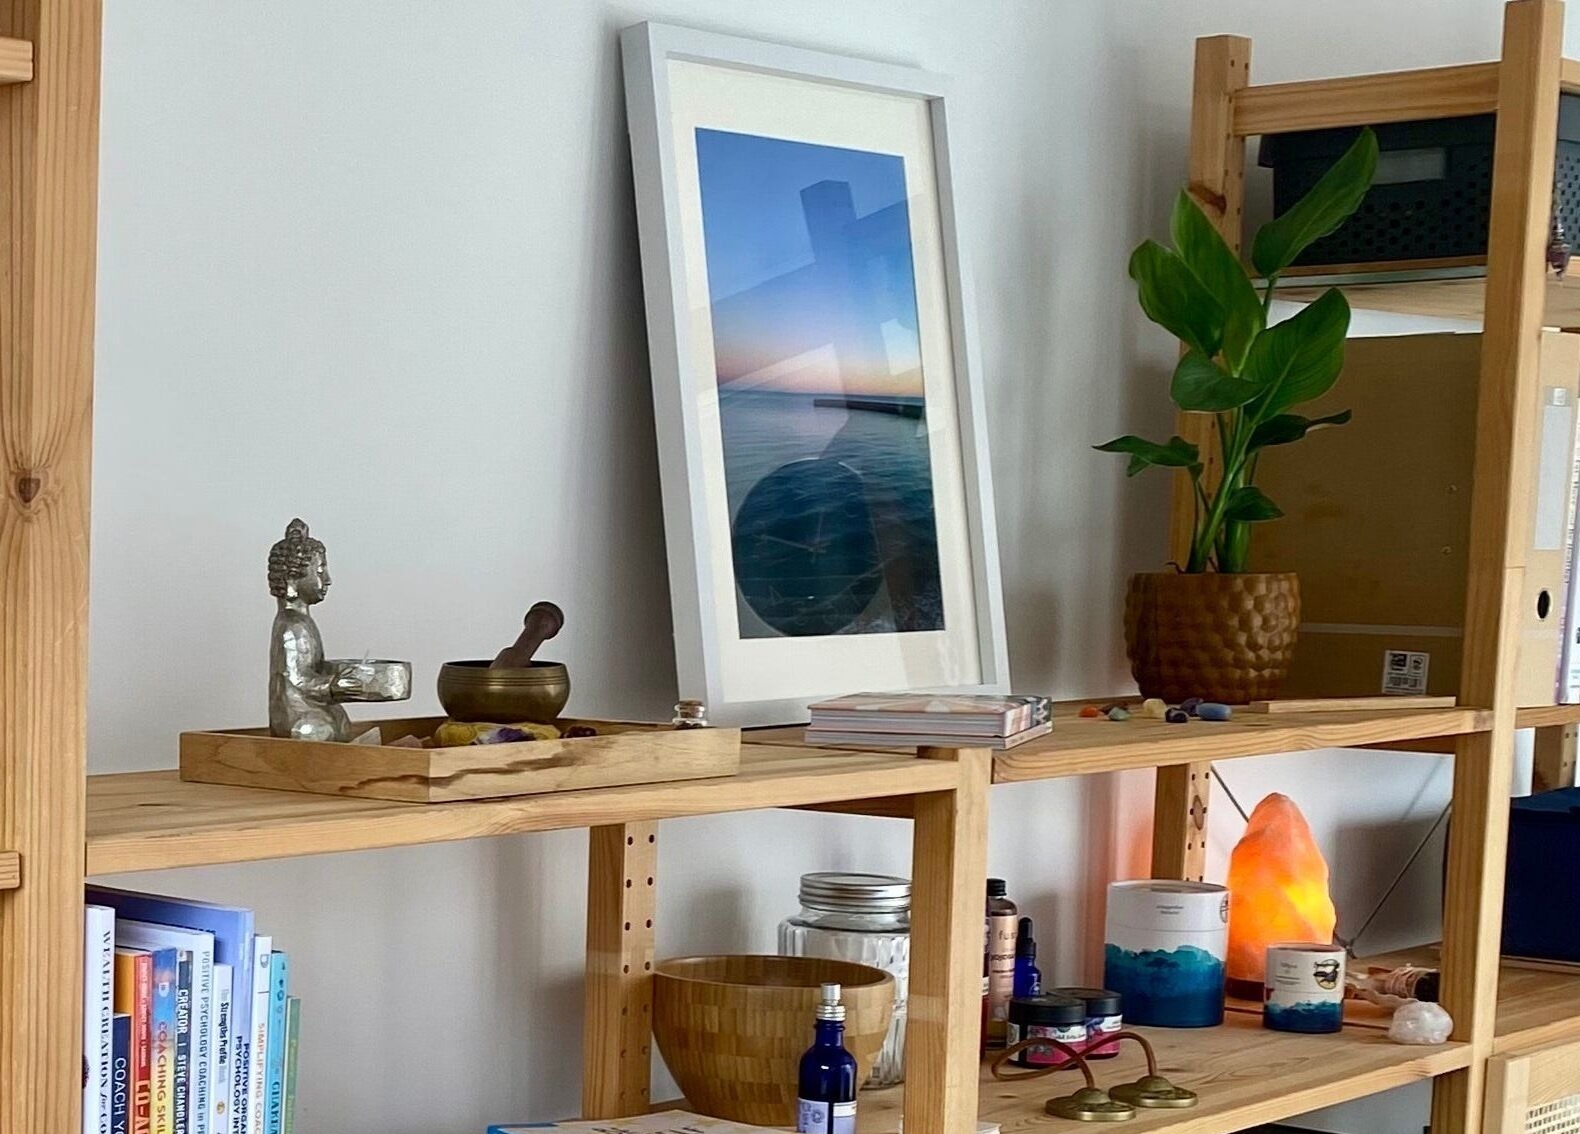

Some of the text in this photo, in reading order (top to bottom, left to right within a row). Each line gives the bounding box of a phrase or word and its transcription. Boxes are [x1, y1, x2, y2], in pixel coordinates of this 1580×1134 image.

[101, 930, 111, 1002] WEALTH
[200, 951, 211, 994] POSITIVE
[177, 988, 189, 1034] CREATOR
[199, 996, 209, 1059] PSYCHOLOGY
[218, 1002, 229, 1039] Strengths
[100, 1005, 110, 1089] CREATION
[156, 1021, 168, 1101] COACHING
[176, 1054, 187, 1084] STEVE
[219, 1039, 228, 1065] Profile
[232, 1034, 243, 1114] PSYCHOLOGY
[241, 1042, 250, 1096] POSITIVE
[255, 1022, 266, 1099] SIMPLIFYING
[100, 1092, 109, 1110] for
[113, 1056, 127, 1116] COACH
[197, 1061, 208, 1110] COACHING
